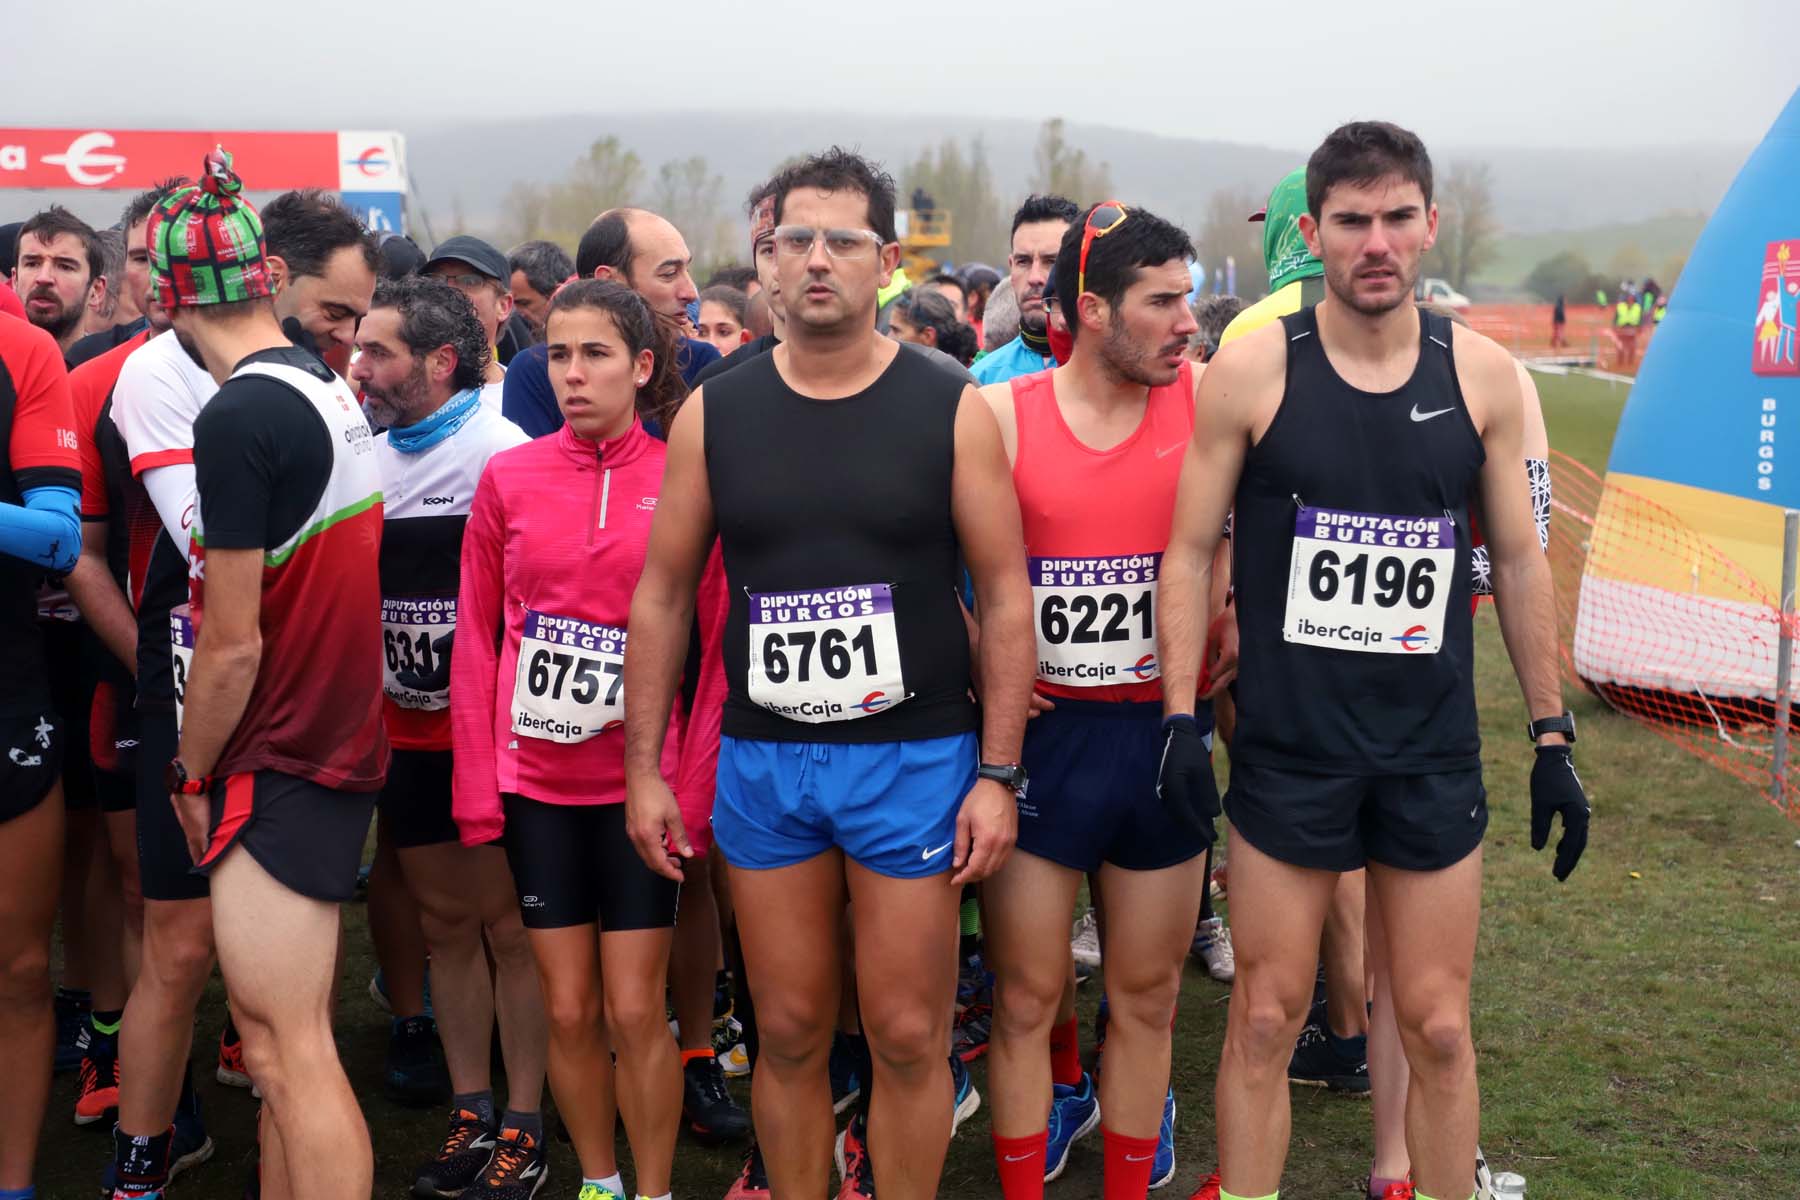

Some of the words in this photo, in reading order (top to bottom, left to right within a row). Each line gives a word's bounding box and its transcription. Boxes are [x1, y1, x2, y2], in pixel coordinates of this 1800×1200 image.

[1757, 398, 1777, 490] BURGOS
[1316, 512, 1440, 534] DIPUTACIÓN
[1314, 525, 1440, 548] BURGOS
[1041, 555, 1154, 572] DIPUTACIÓN
[1041, 568, 1154, 586] BURGOS
[1308, 549, 1437, 610] 6196
[382, 598, 456, 612] DIPUTACIÓN
[760, 586, 872, 608] DIPUTACIÓN
[381, 610, 457, 624] BURGOS
[761, 600, 874, 623] BURGOS
[1041, 590, 1153, 645] 6221
[1297, 618, 1382, 646] iberCaja
[763, 624, 878, 684] 6761
[528, 649, 624, 707] 6757
[1040, 661, 1116, 680] iberCaja
[764, 700, 843, 717] iberCaja
[518, 712, 582, 738] iberCaja
